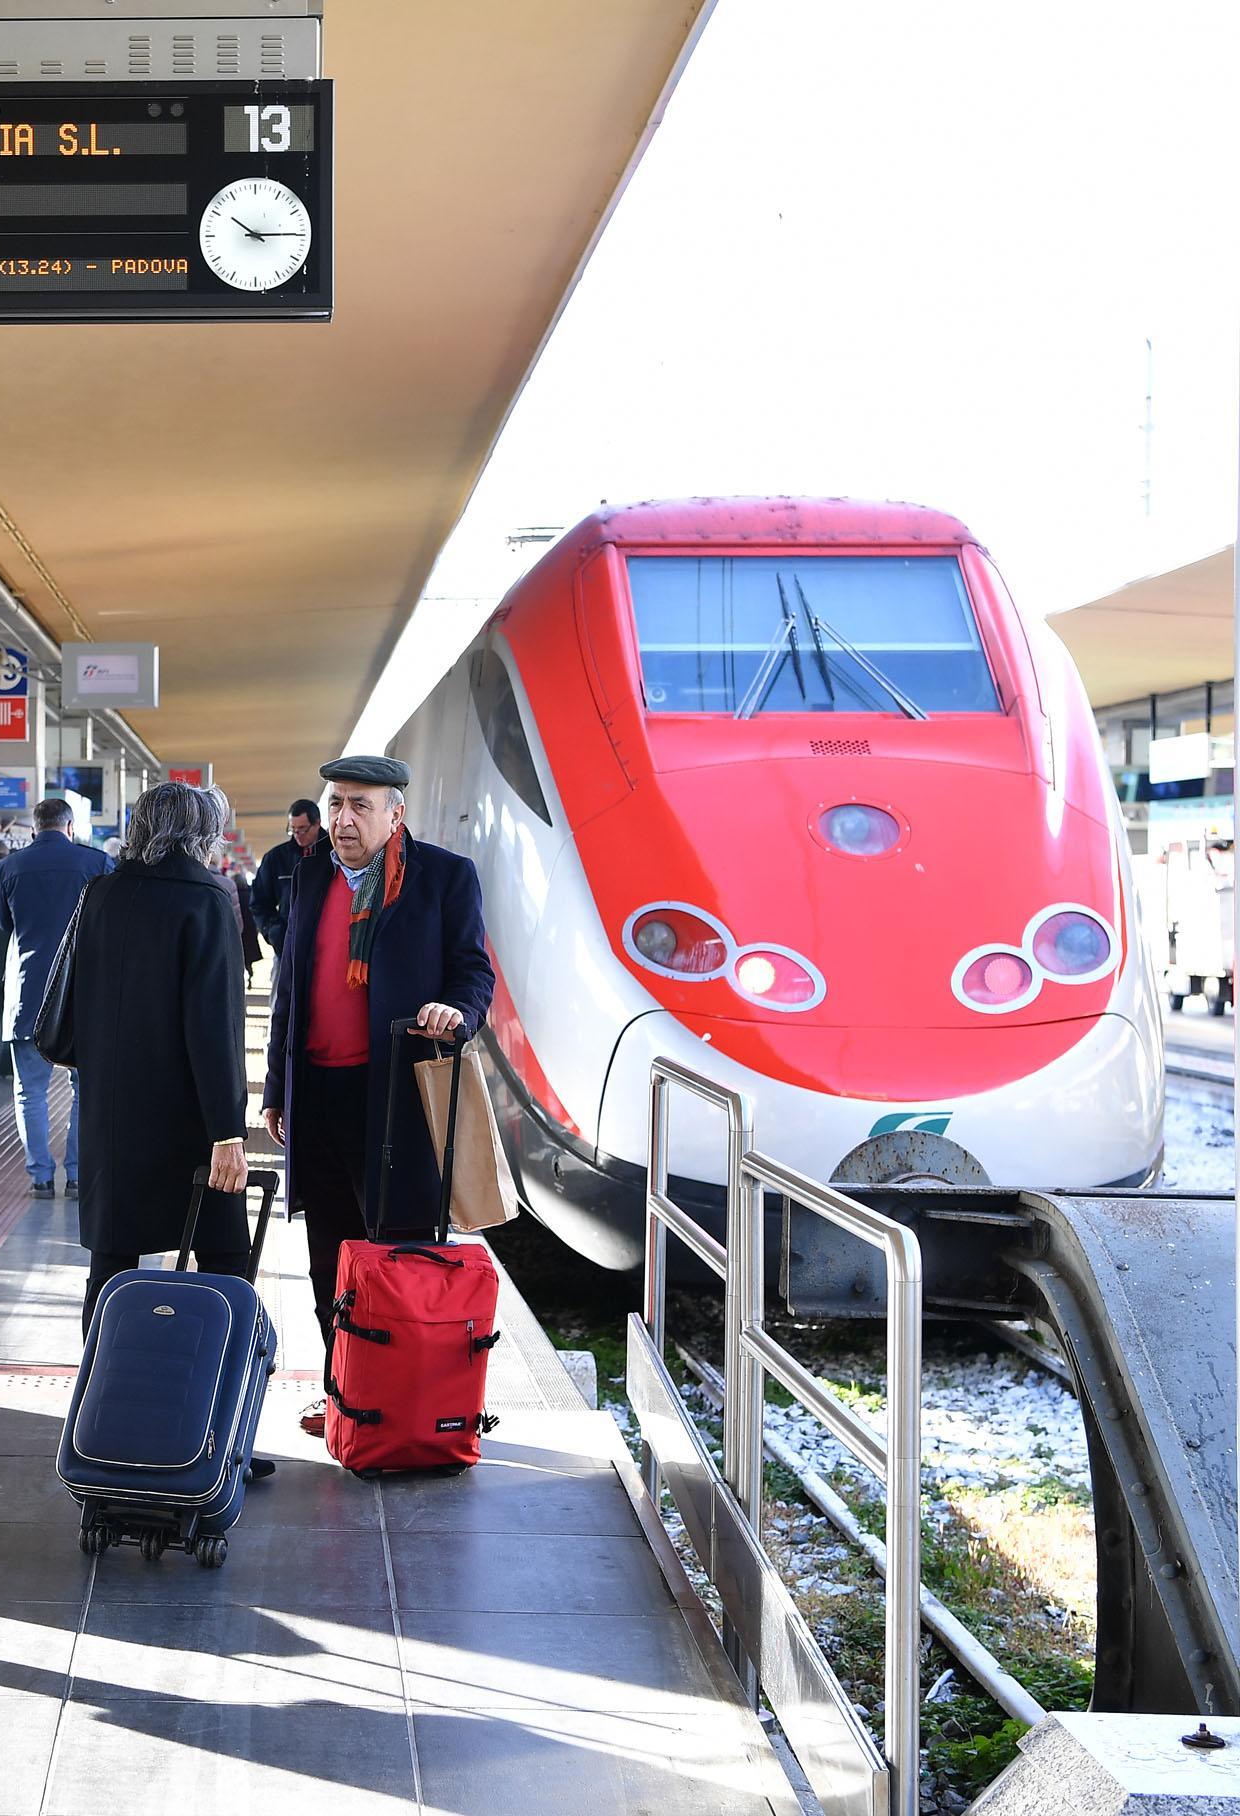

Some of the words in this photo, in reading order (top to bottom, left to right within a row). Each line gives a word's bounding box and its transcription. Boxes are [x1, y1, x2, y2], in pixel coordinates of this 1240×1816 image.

[59, 124, 121, 156] S.L.
[243, 105, 291, 152] 13
[0, 259, 73, 275] (13.24)
[111, 259, 189, 274] PADOVA
